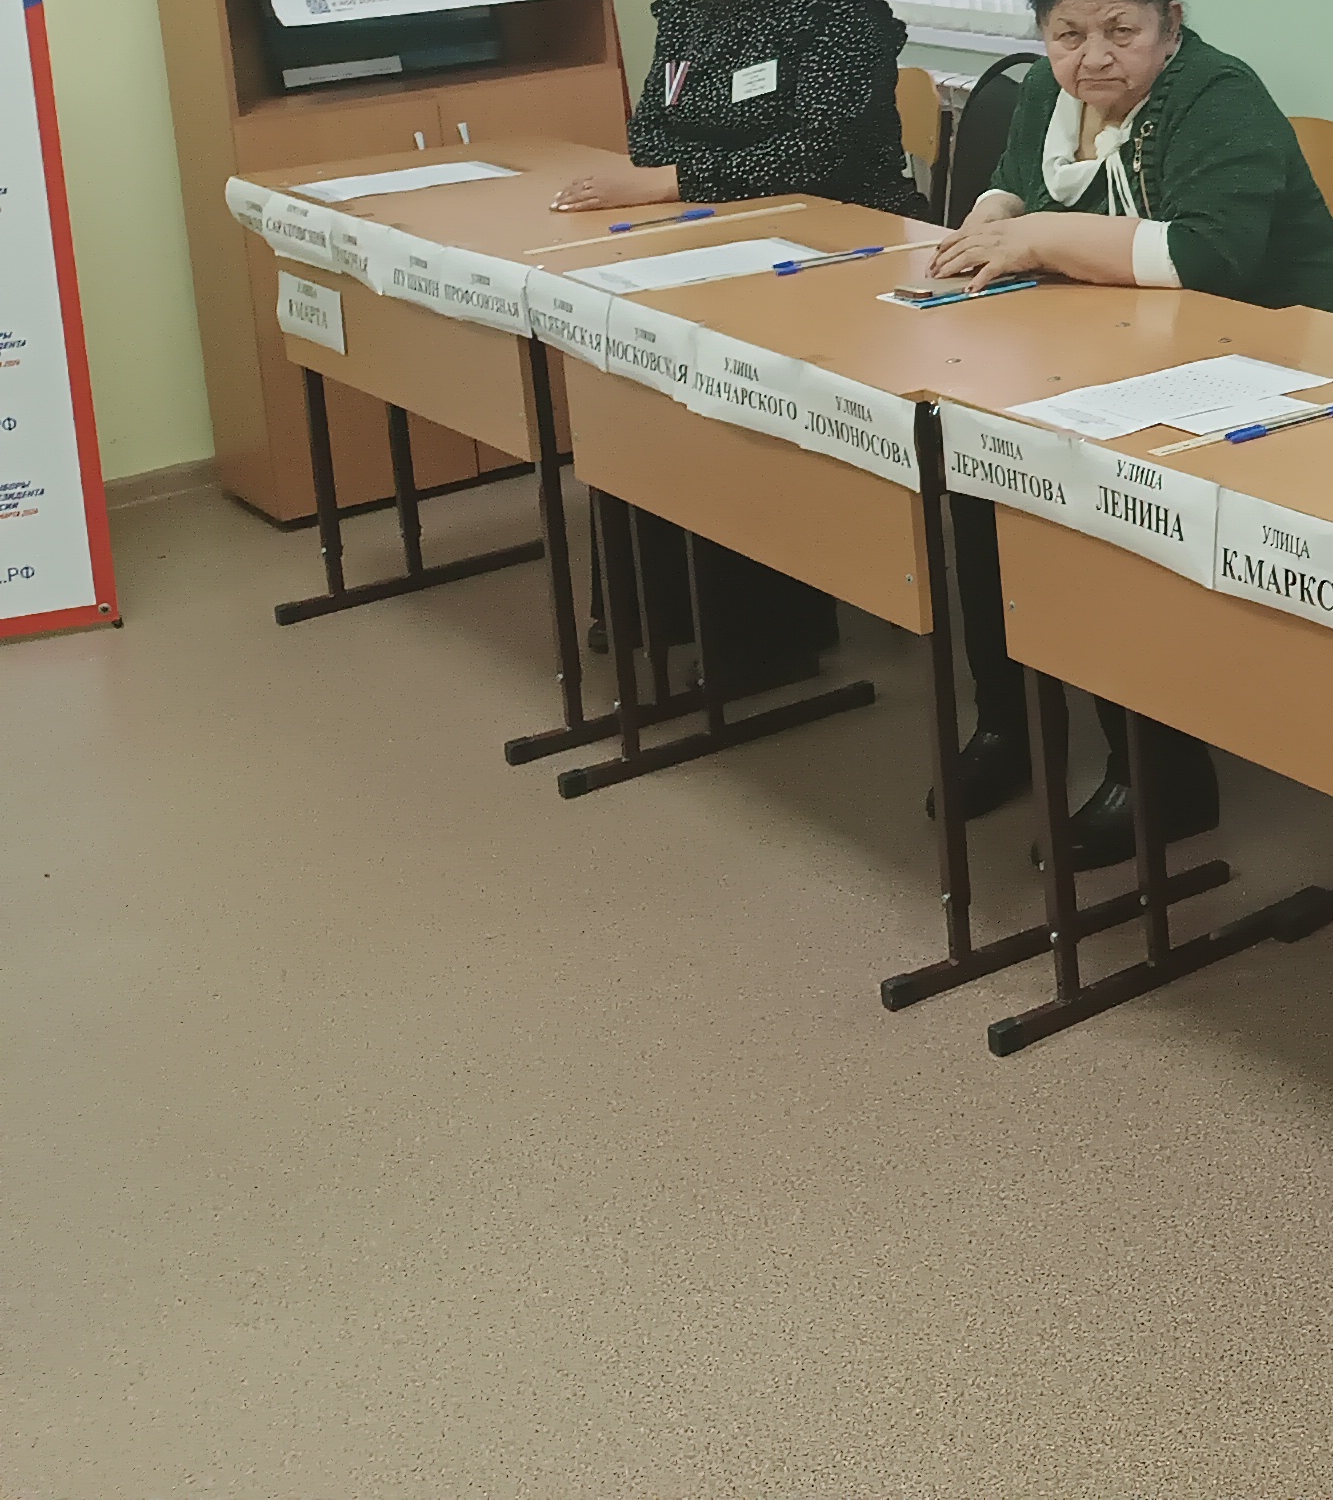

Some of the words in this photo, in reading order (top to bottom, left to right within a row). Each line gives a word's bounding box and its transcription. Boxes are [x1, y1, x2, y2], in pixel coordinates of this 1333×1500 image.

[606, 336, 688, 384] МОСКОВСКАЯ
[724, 357, 760, 382] УЛИЦА
[835, 395, 873, 423] УЛИЦА
[804, 410, 912, 469] ЛОМОНОСОВА
[980, 433, 1023, 462] УЛИЦА
[950, 451, 1067, 507] ЛЕРМОНТОВА
[1115, 459, 1163, 491] УЛИЦА
[1096, 485, 1185, 543] ЛЕНИНА
[1261, 525, 1311, 560] УЛИЦА
